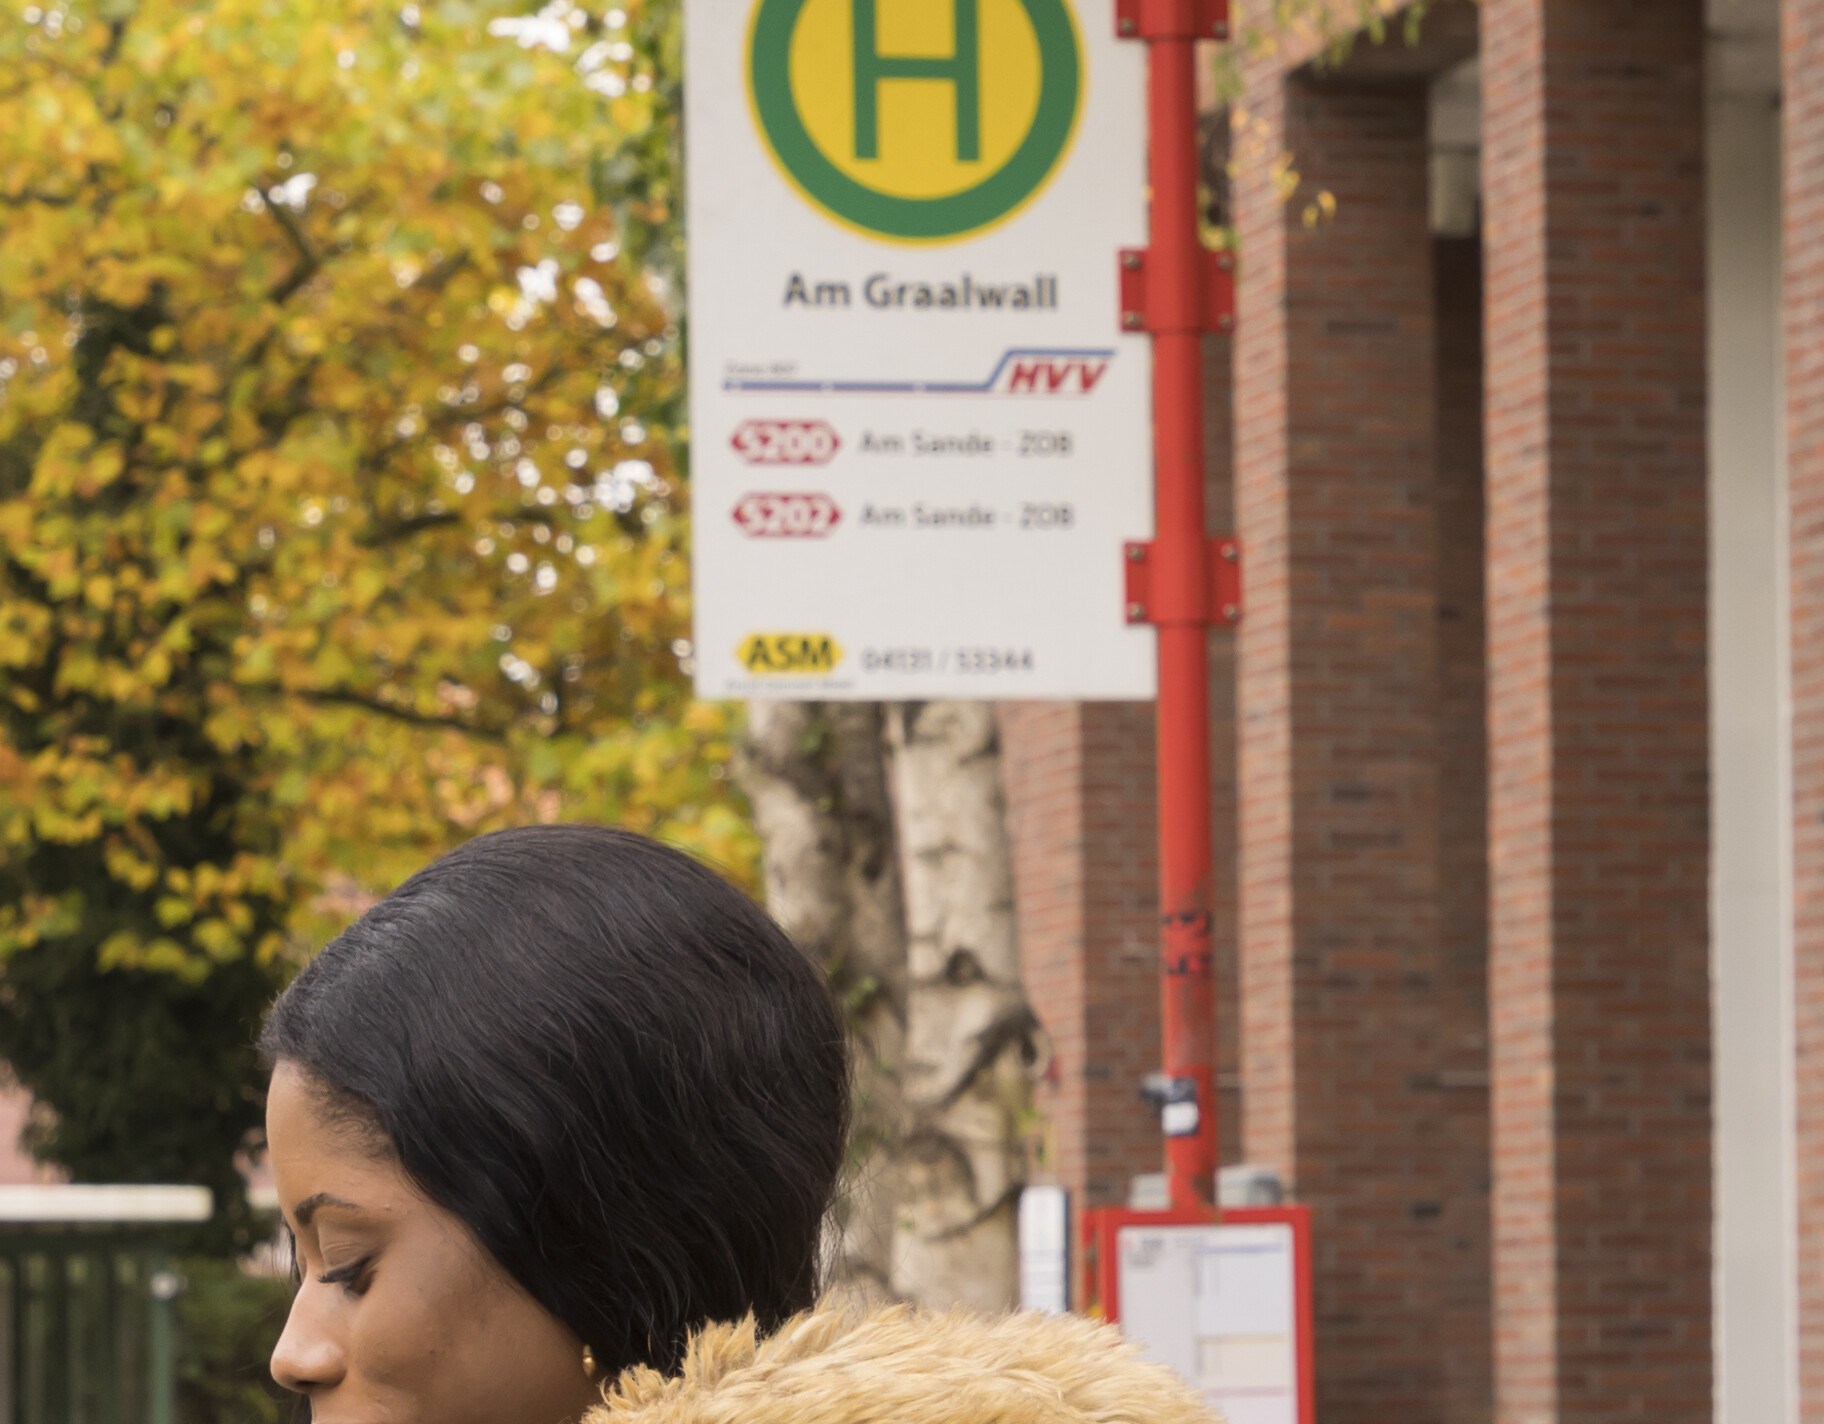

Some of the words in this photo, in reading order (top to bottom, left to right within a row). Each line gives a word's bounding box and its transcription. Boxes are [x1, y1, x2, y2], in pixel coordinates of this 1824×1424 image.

[852, 0, 981, 163] H
[783, 274, 852, 310] Am
[862, 272, 1059, 312] Graalwall
[1008, 360, 1109, 395] HVV
[858, 432, 904, 456] Am
[912, 429, 996, 457] Sande
[1018, 431, 1074, 458] ZOB
[858, 505, 905, 529] Am
[912, 502, 997, 530] Sande
[1018, 503, 1075, 530] ZOB
[746, 635, 833, 669] ASM
